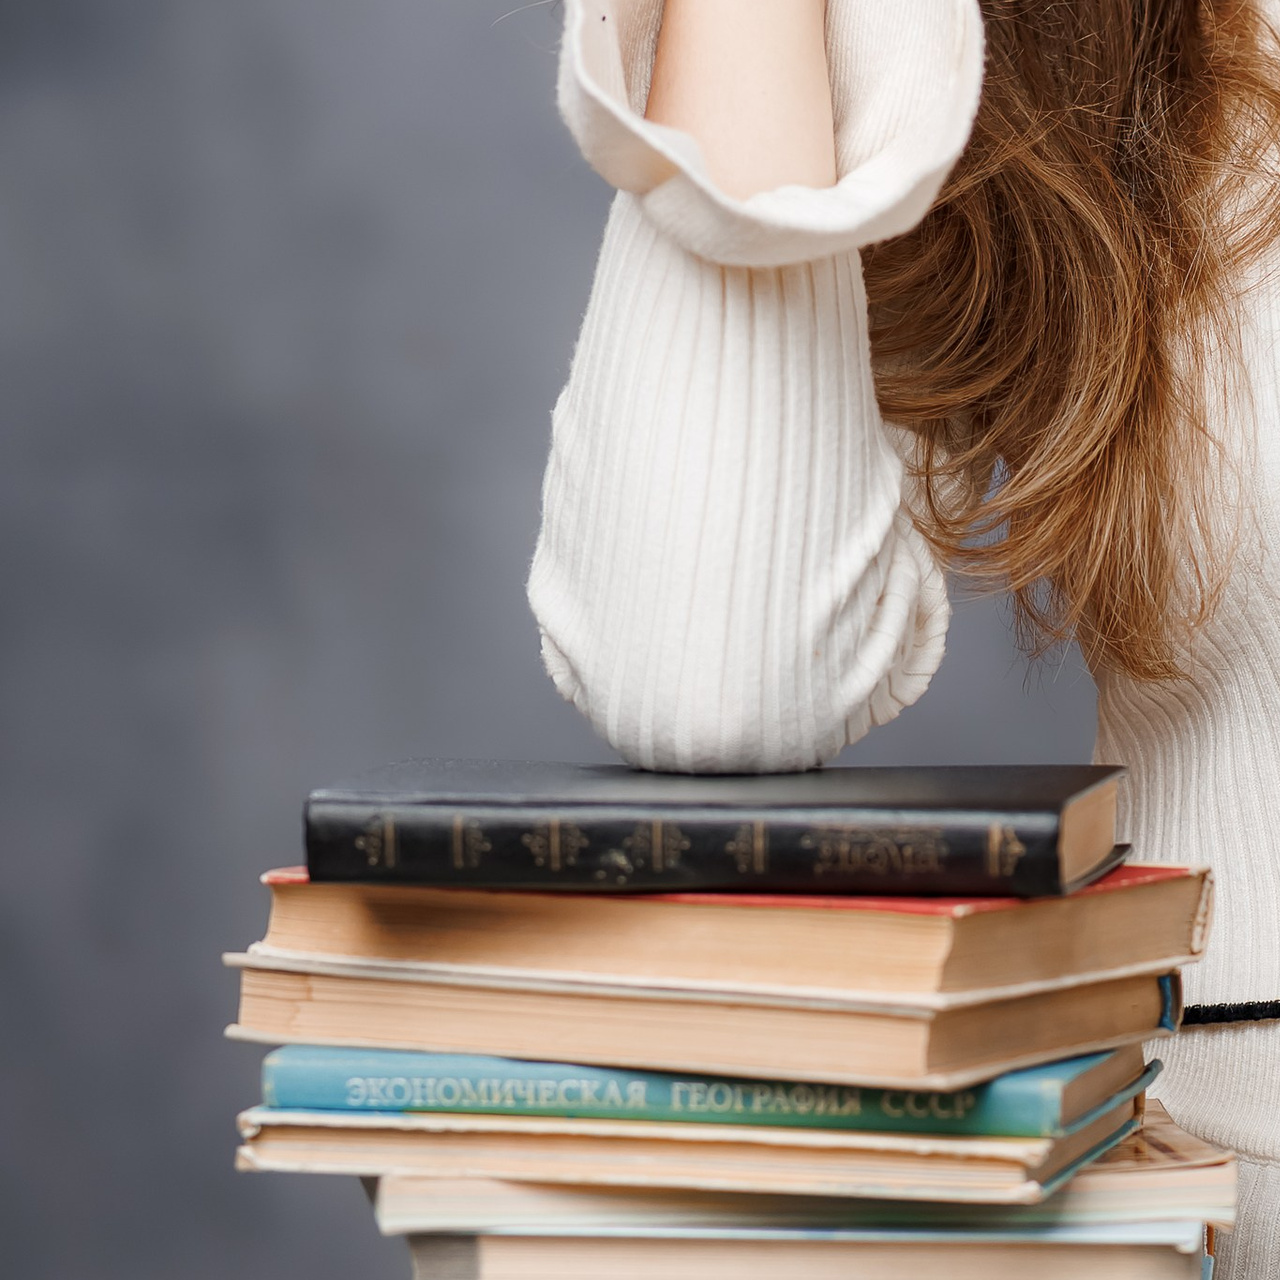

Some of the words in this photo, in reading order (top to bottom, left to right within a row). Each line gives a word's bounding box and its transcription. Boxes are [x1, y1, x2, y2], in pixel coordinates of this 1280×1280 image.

[346, 1077, 646, 1107] ЭКОНОМИЧЕСКАЯ
[670, 1081, 861, 1114] ГЕОГРАФИЯ
[881, 1088, 974, 1117] СССР
